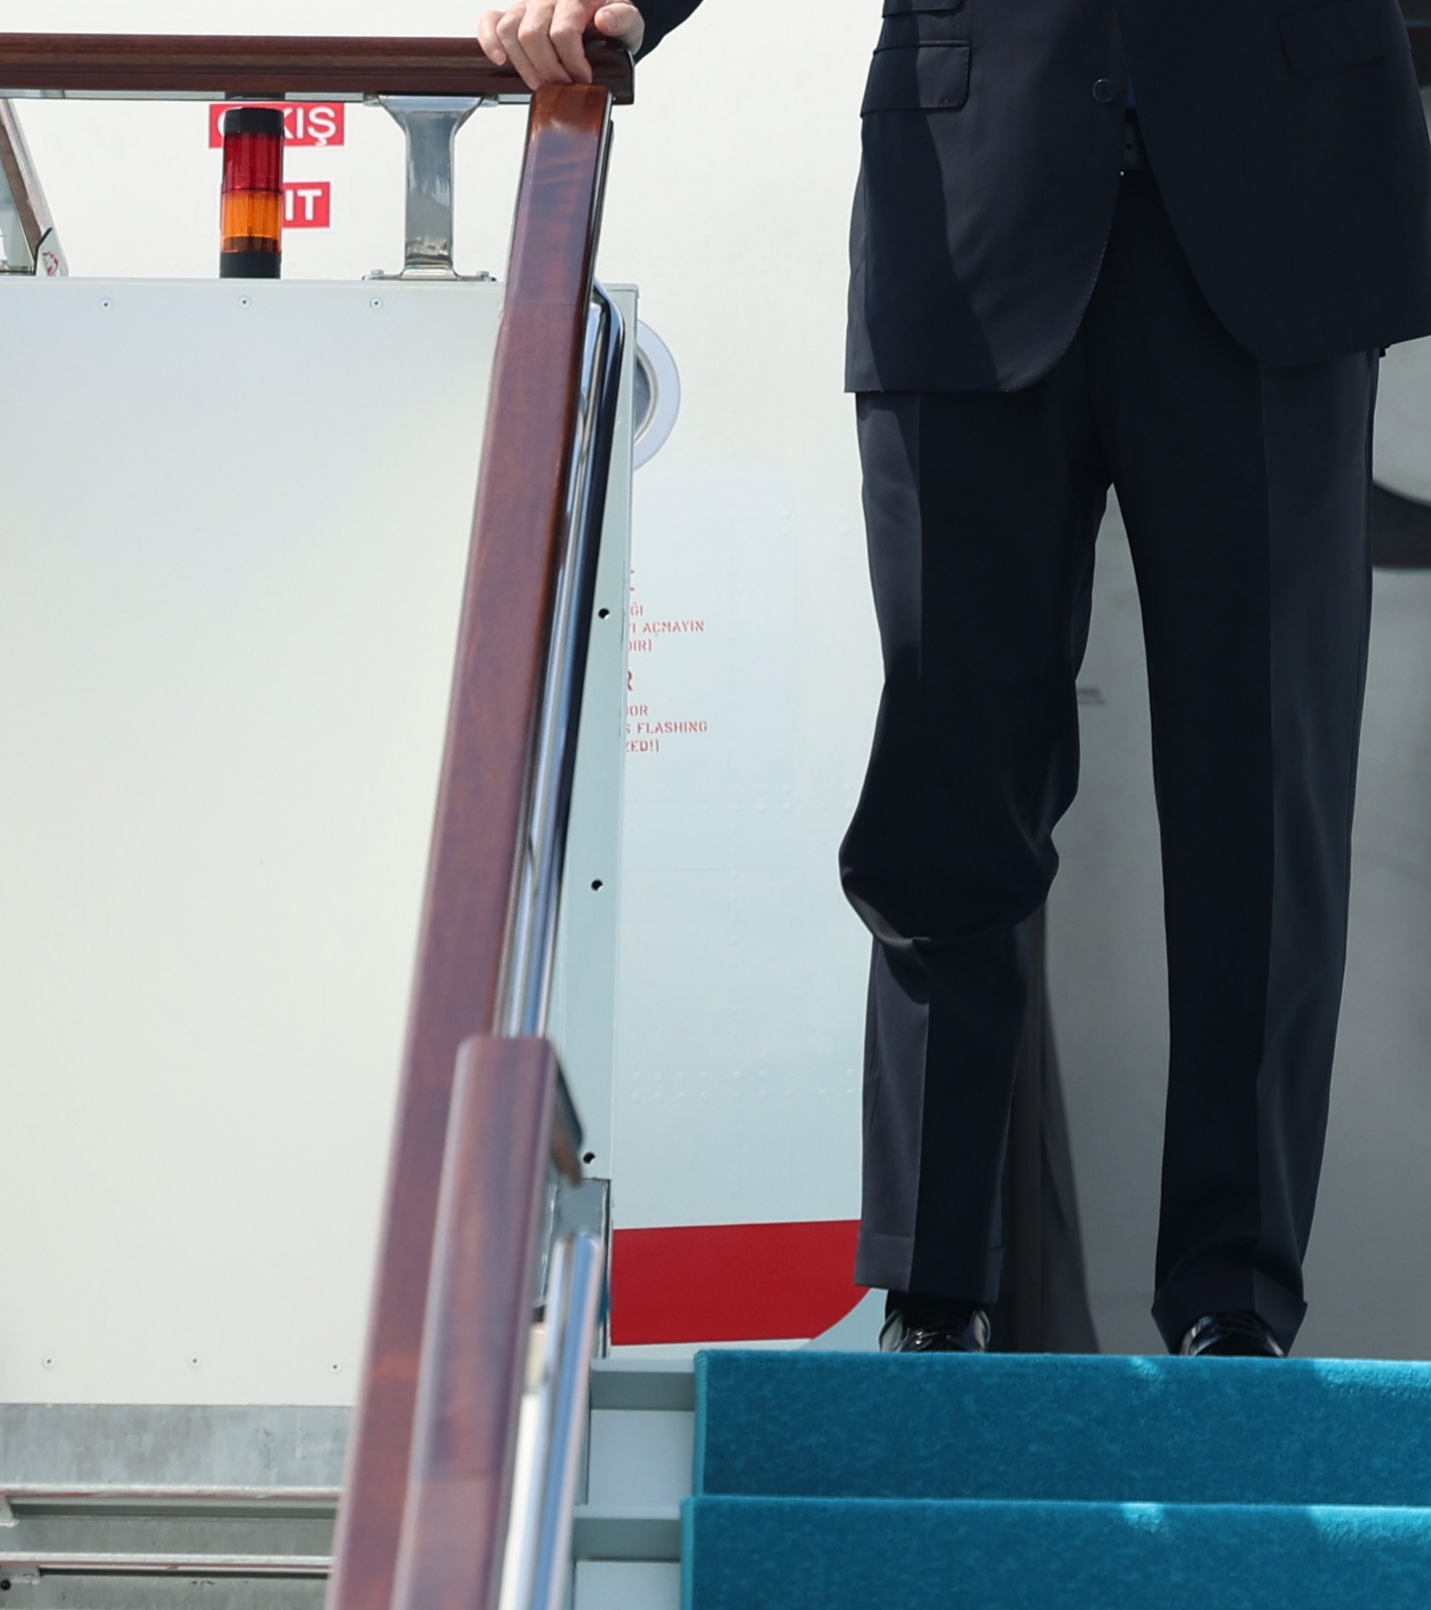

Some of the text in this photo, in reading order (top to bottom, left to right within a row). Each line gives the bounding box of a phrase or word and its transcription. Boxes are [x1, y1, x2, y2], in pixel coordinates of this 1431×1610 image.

[285, 189, 323, 221] IT
[642, 620, 704, 637] AÇMAYIN
[637, 720, 708, 734] FLASHING
